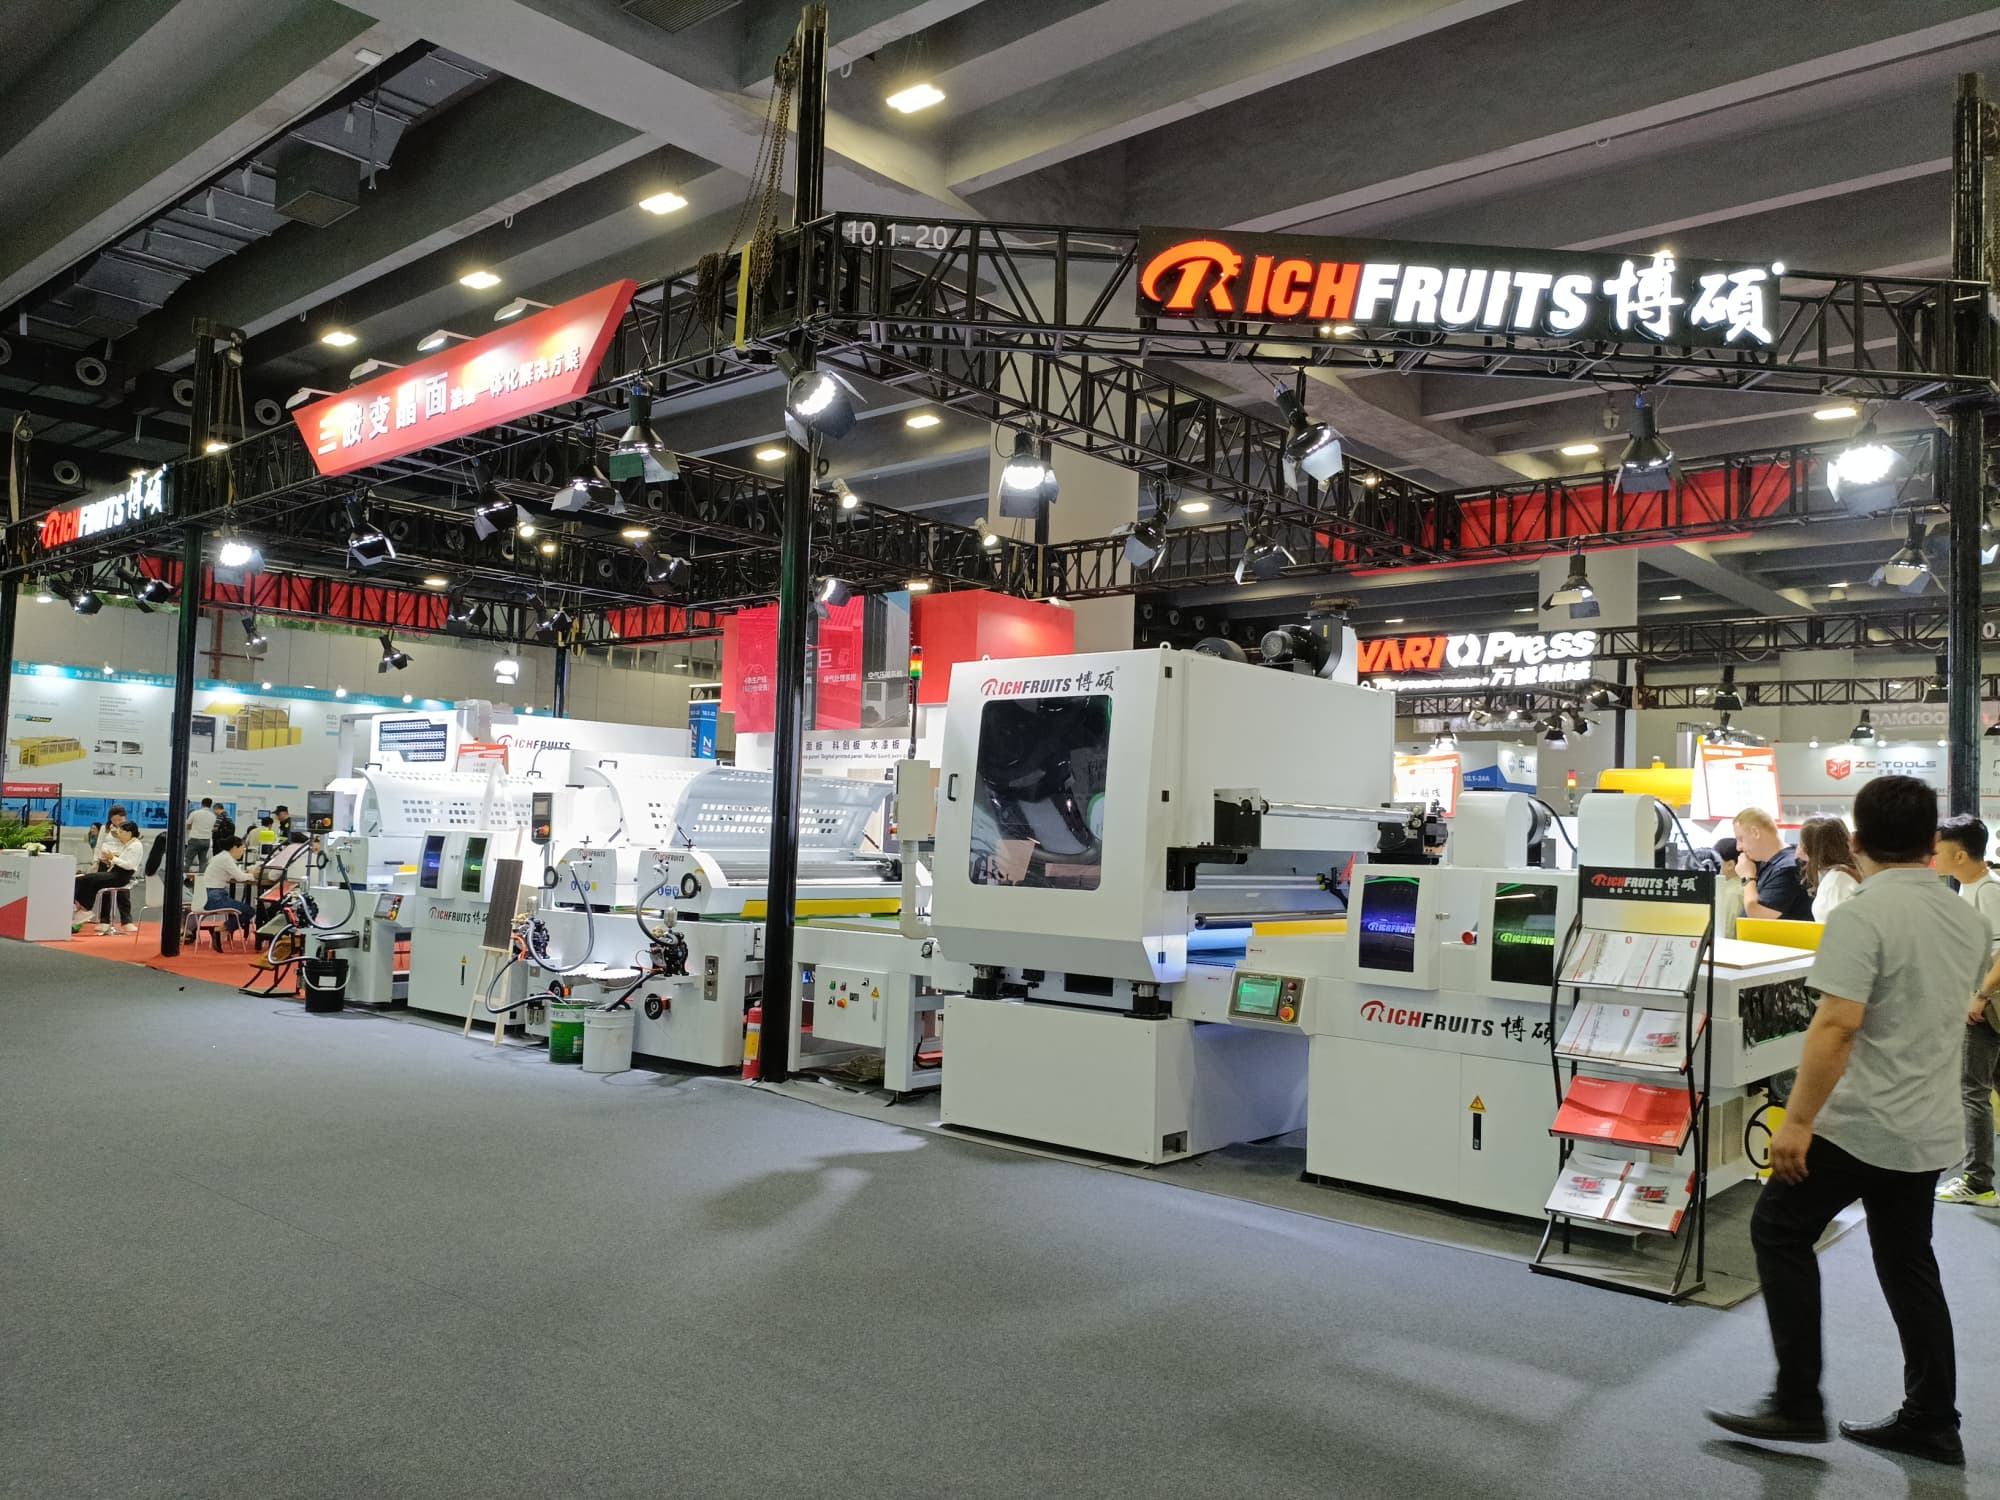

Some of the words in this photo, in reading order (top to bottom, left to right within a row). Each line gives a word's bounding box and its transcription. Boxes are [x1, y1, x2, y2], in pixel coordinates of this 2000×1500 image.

[847, 221, 948, 249] 10.1-20
[1141, 241, 1592, 331] RICHFRUITS
[981, 678, 1072, 696] RICHFRUITS
[1591, 874, 1663, 889] RICHFRUITS
[1360, 1000, 1495, 1037] RICHFRUITS
